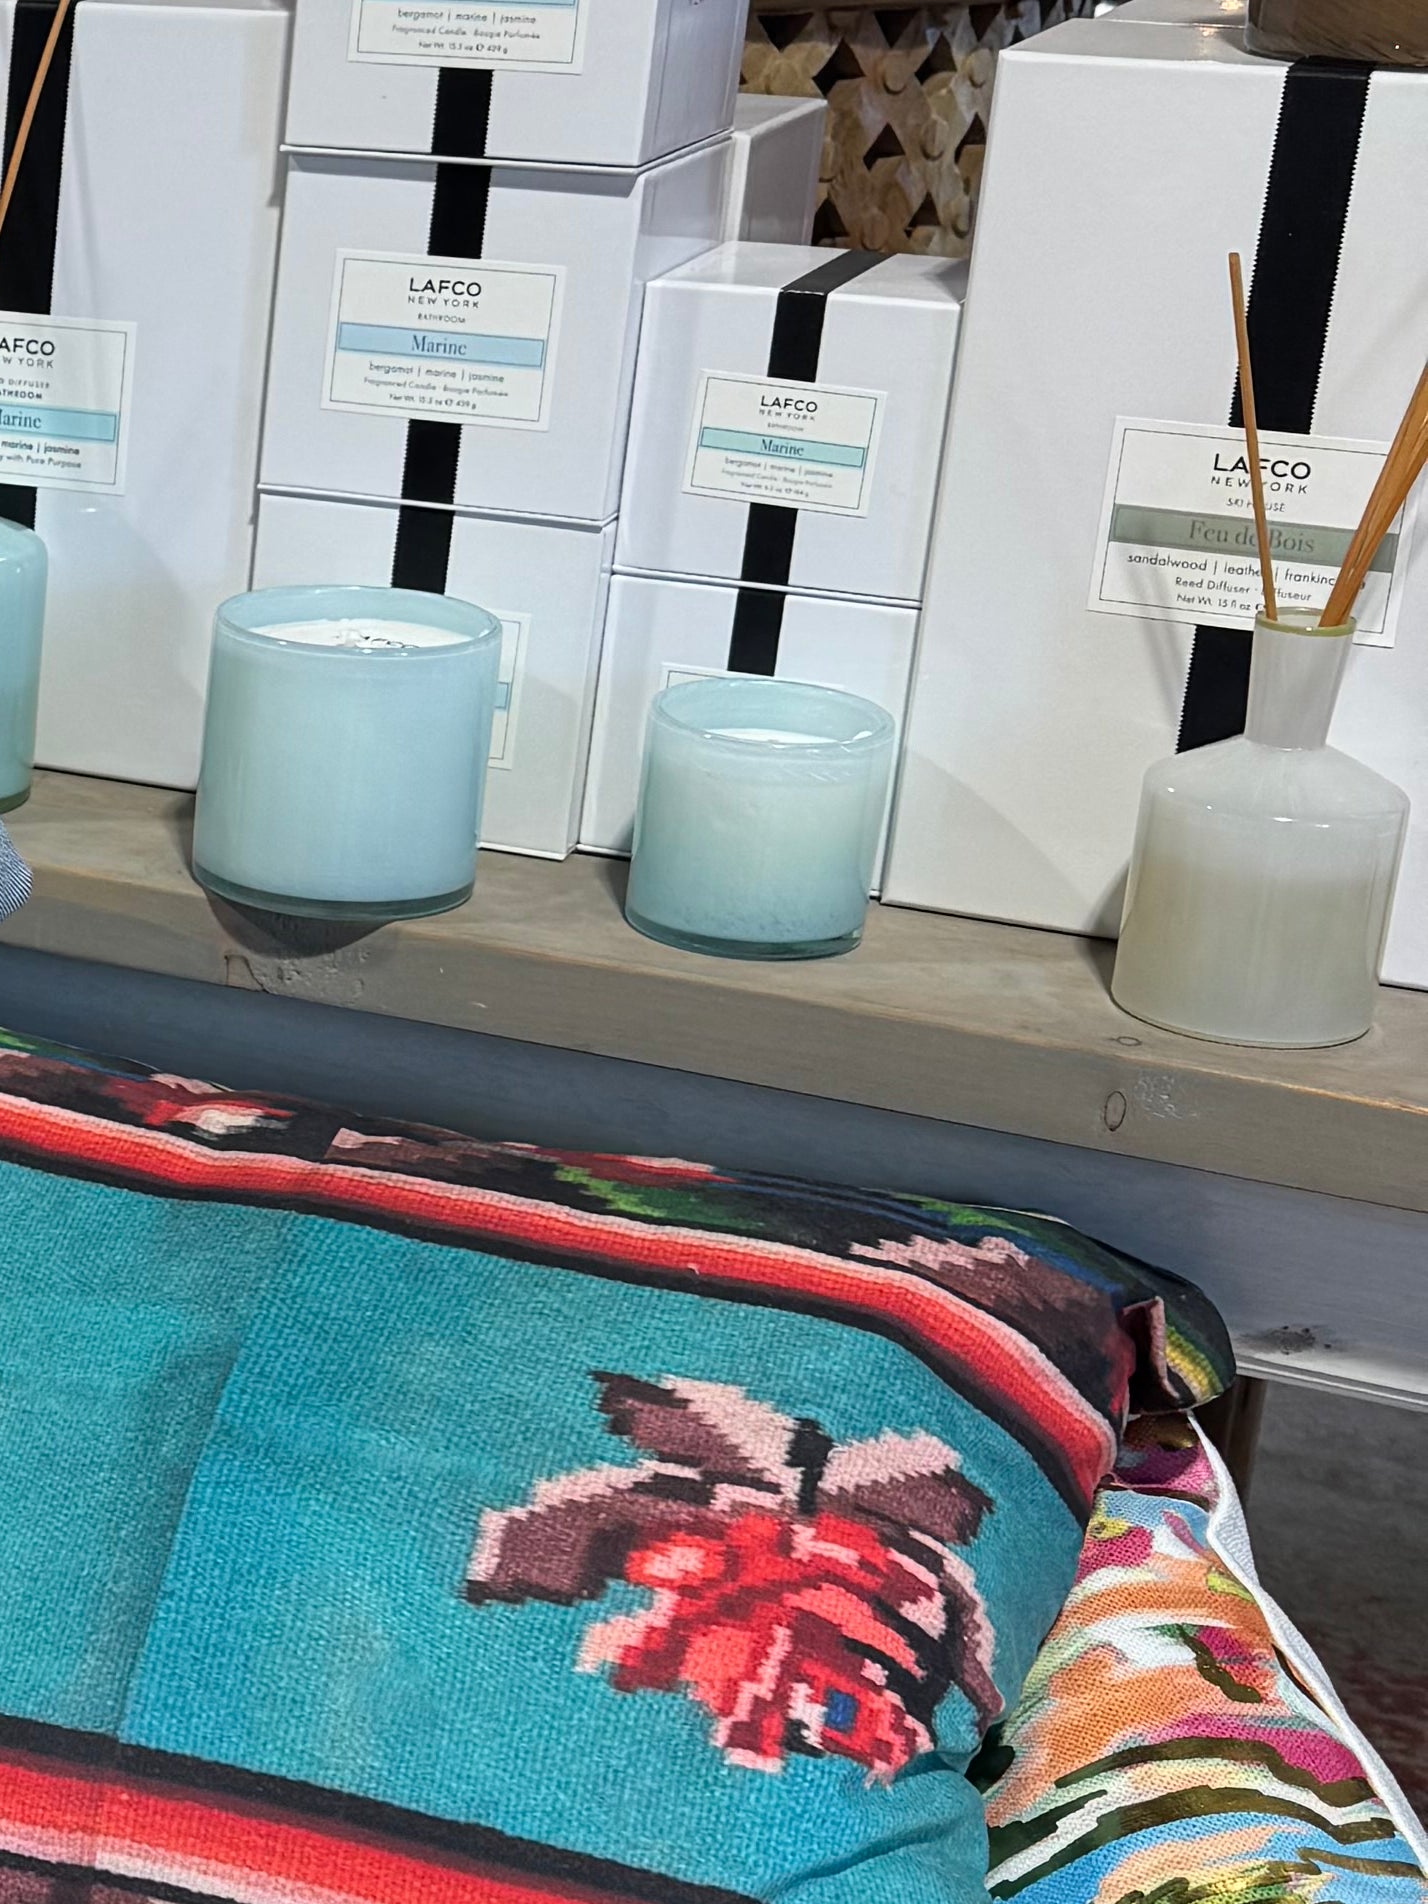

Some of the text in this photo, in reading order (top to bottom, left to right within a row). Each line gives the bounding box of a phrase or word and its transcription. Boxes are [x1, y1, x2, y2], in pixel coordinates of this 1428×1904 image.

[409, 277, 482, 297] LAFCO
[407, 295, 479, 308] NEW YORK
[411, 334, 467, 356] Marine
[18, 357, 54, 368] YORK
[369, 361, 413, 376] bergamot
[760, 395, 818, 413] LAFCO
[758, 408, 816, 422] NEW YORK
[760, 439, 805, 457] Marine
[1211, 476, 1308, 494] NEW ORK
[1189, 519, 1229, 544] Feu
[1269, 528, 1315, 553] Bois
[1127, 551, 1208, 573] sandalwood
[1224, 561, 1261, 577] leathe
[1175, 576, 1204, 589] Reed
[1207, 580, 1250, 595] Diffuser
